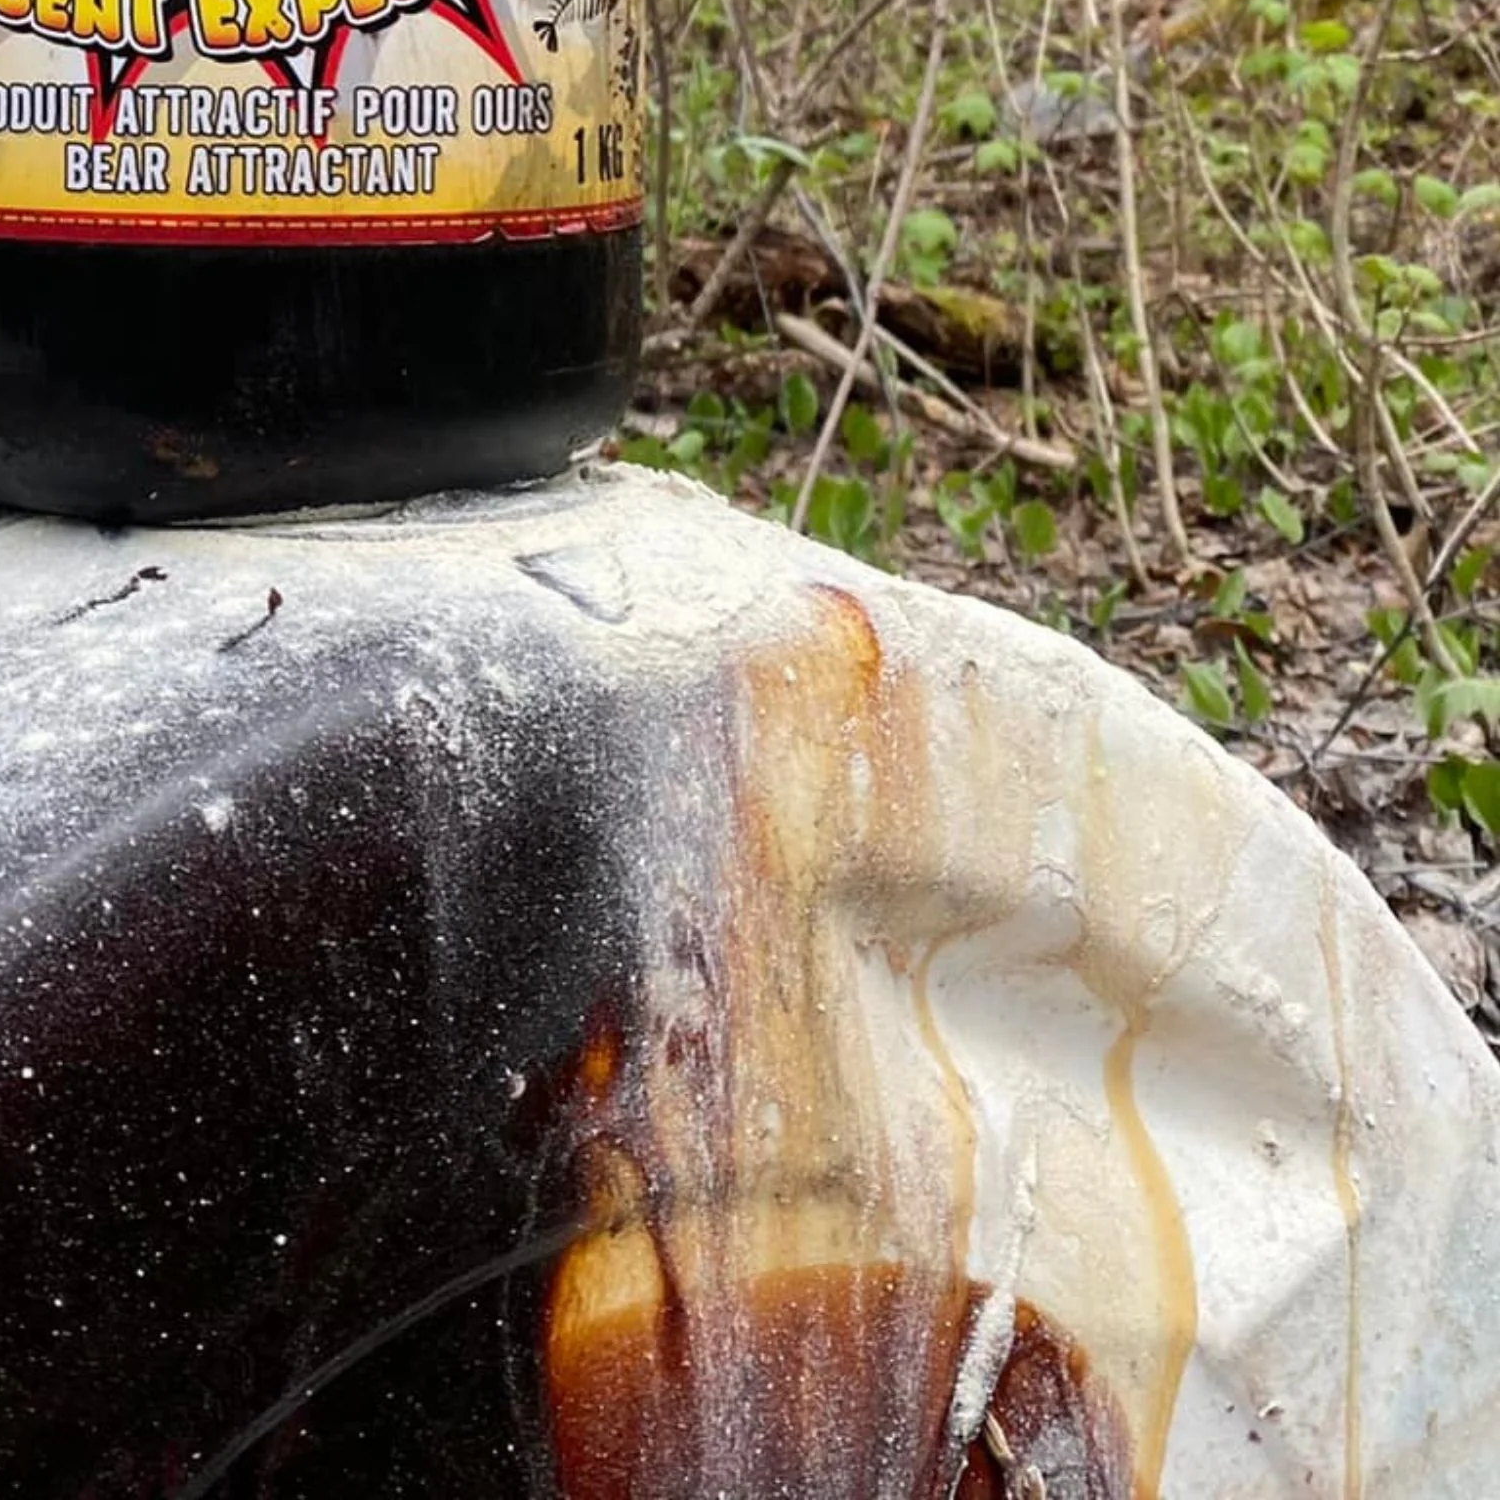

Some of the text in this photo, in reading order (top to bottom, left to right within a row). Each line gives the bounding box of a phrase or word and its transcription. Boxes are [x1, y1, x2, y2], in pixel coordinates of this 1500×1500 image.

[115, 84, 336, 137] ATTRACTIF
[354, 87, 459, 136] POUR
[473, 85, 553, 135] OURS
[65, 143, 440, 195] BEAR ATTRACTANT
[573, 125, 626, 184] 1 KG
